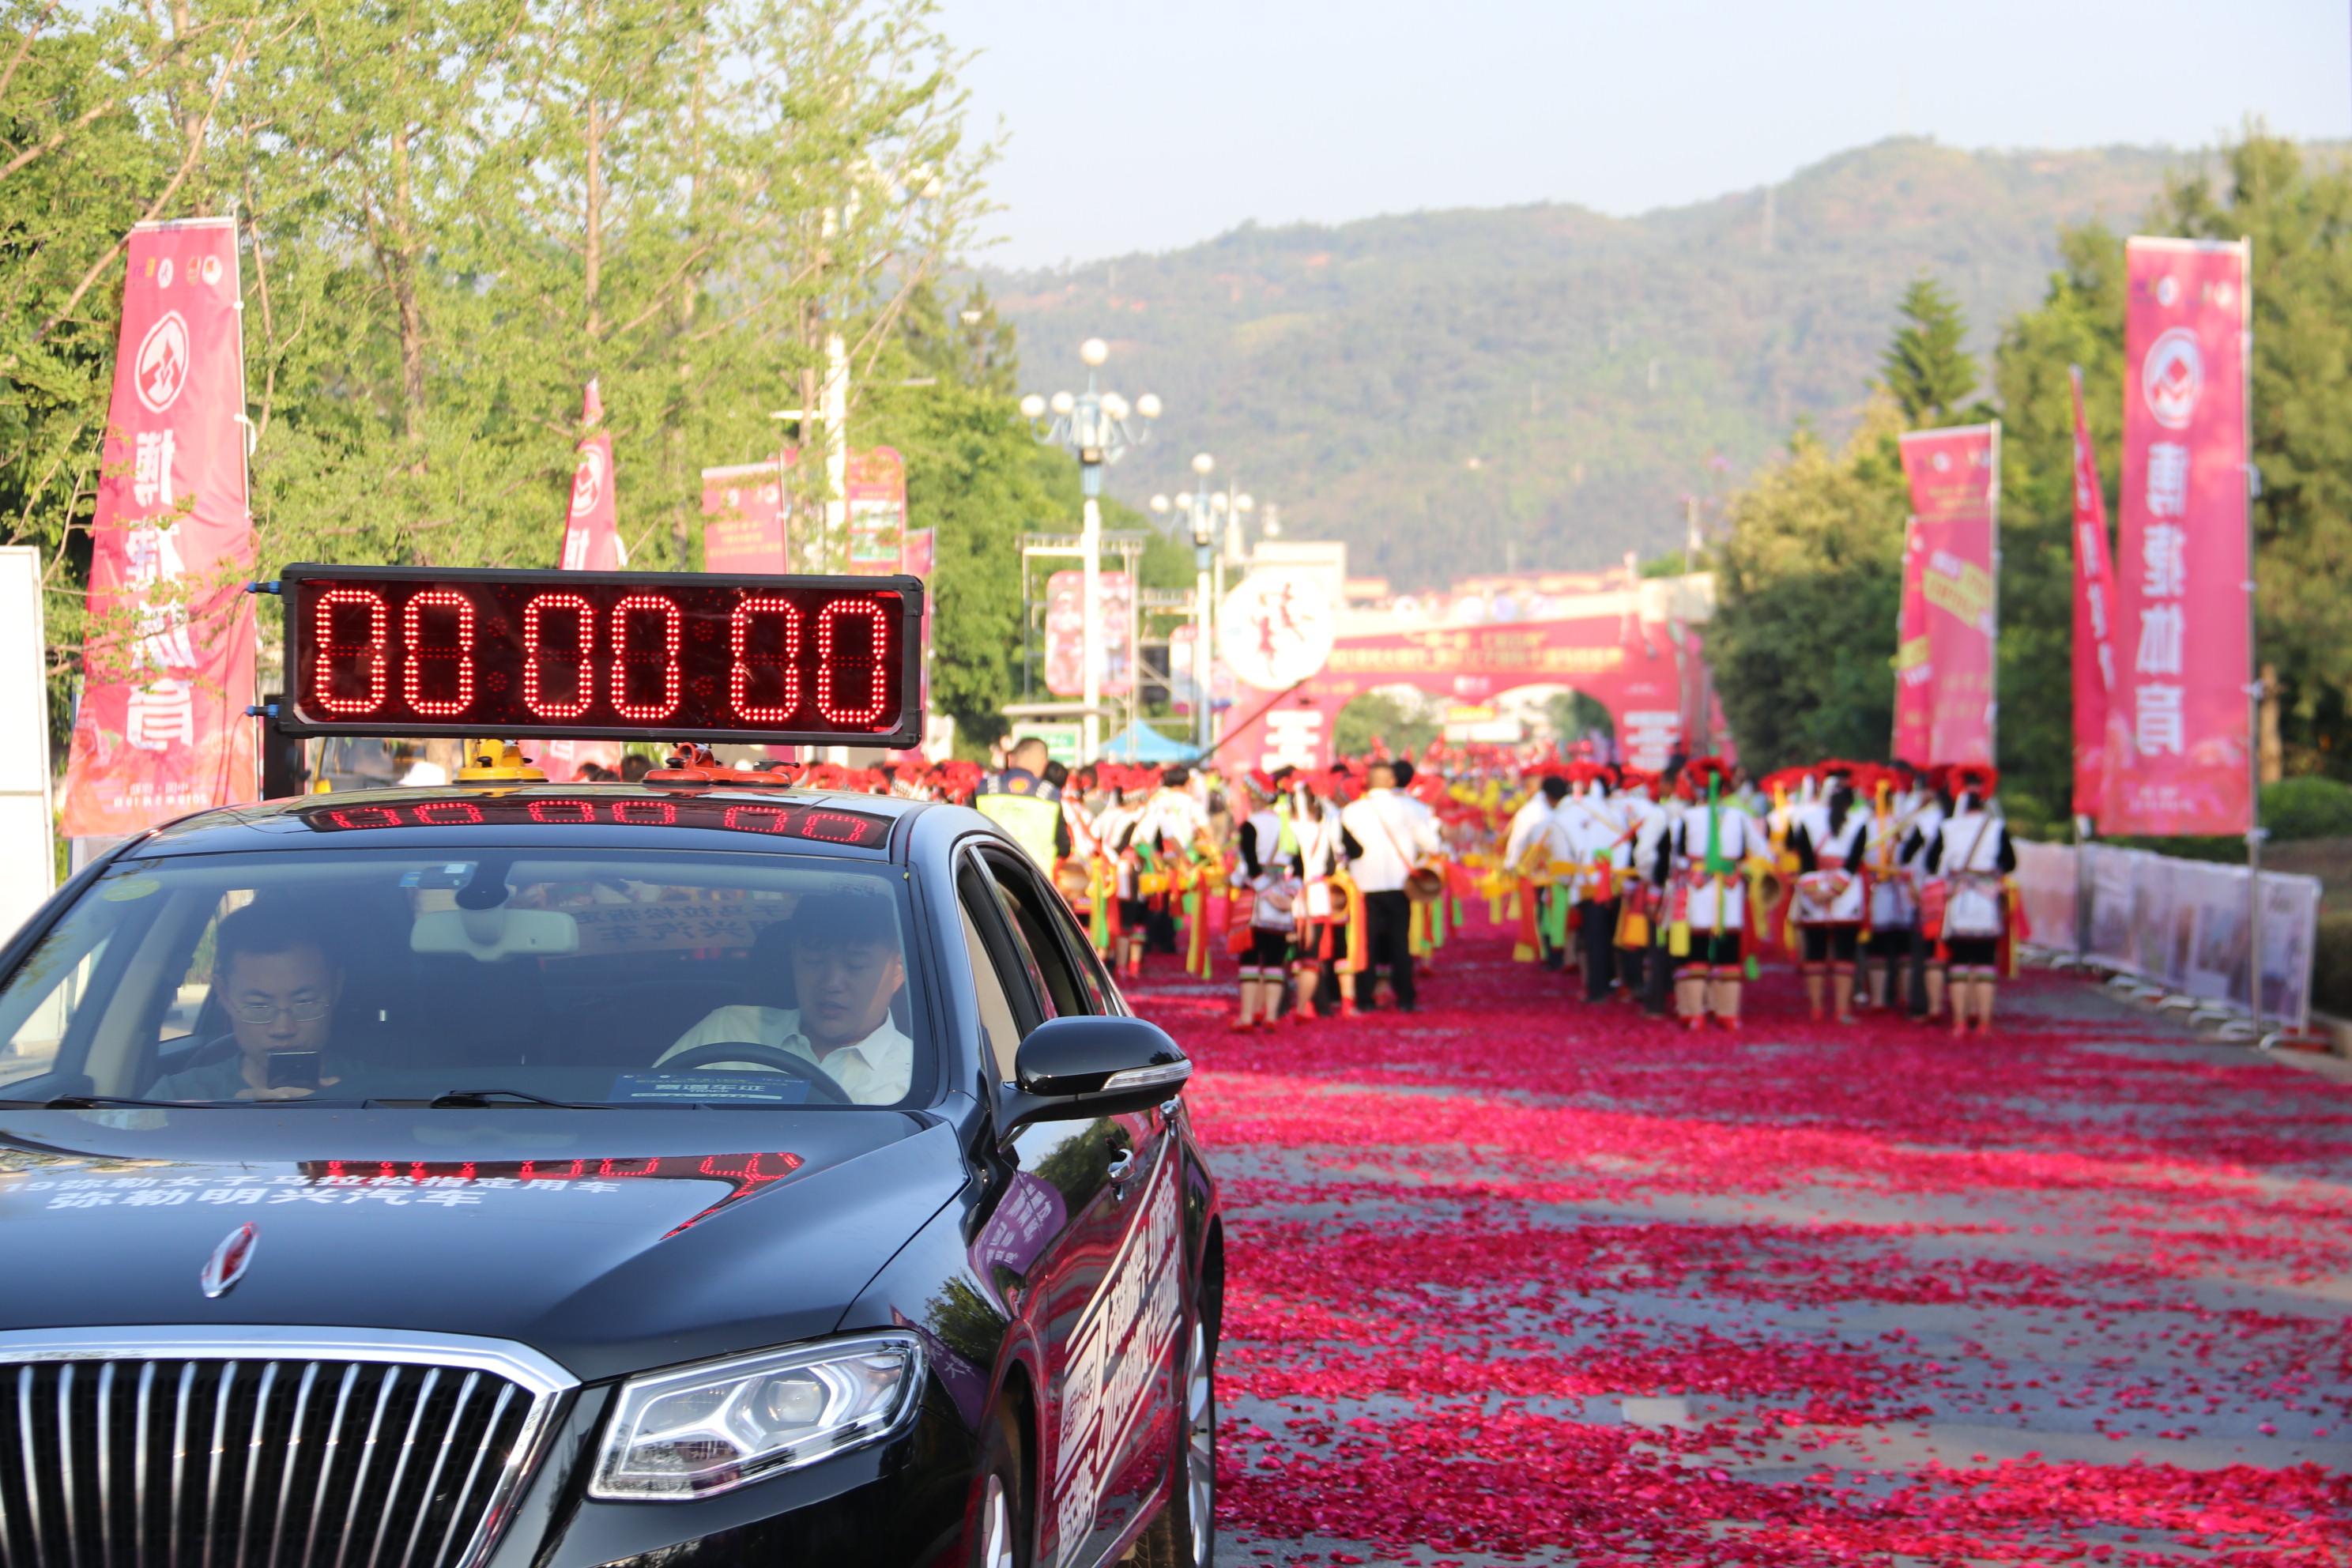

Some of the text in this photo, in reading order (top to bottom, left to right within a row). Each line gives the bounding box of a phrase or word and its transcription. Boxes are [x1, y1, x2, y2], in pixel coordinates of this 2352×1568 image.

[45, 1188, 488, 1211] 弥勒明兴汽车
